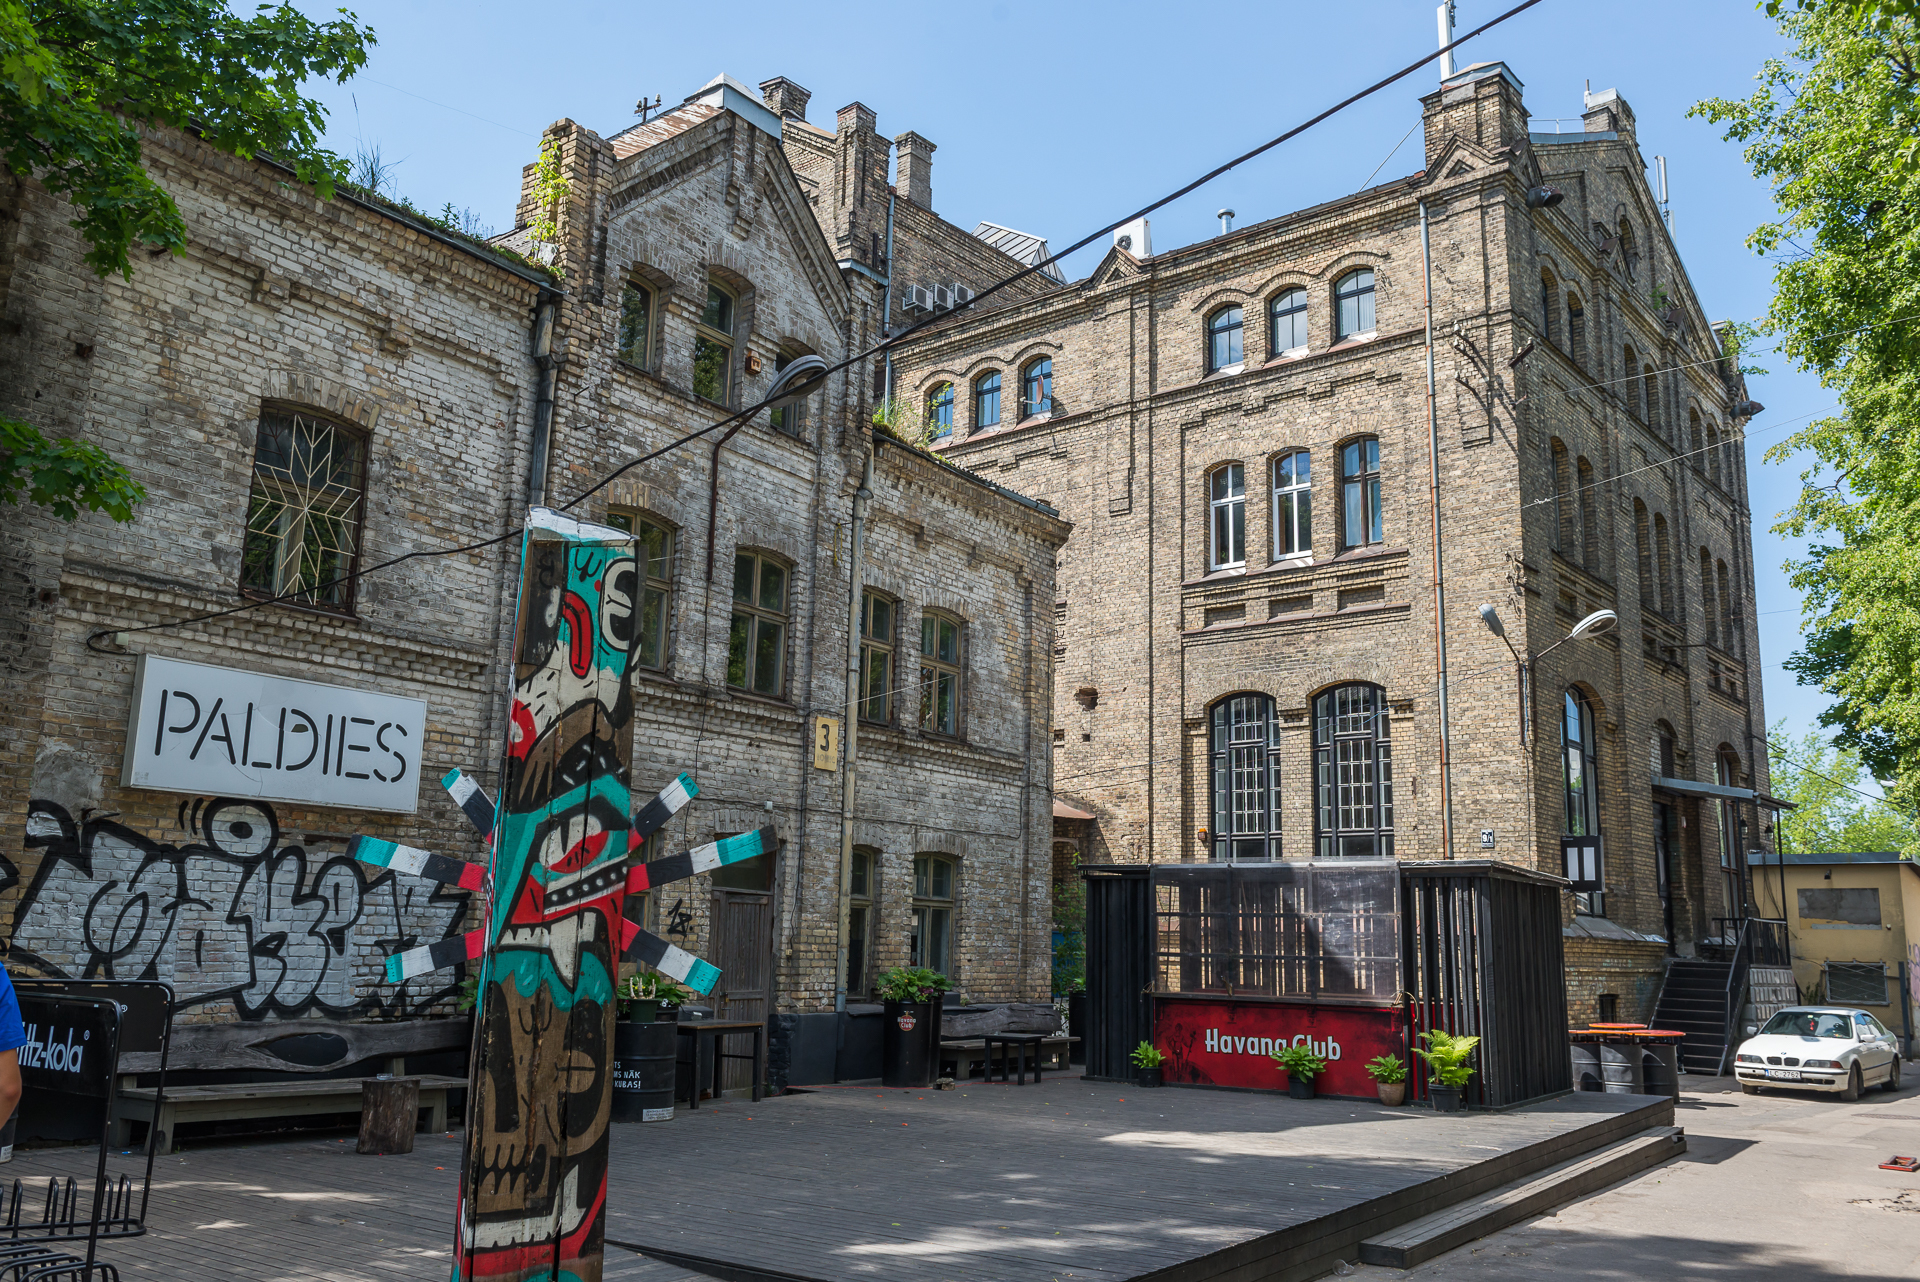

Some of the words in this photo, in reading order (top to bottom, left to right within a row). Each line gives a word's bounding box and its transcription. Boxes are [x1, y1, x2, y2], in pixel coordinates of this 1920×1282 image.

[155, 689, 407, 783] PALDIES
[820, 724, 830, 751] 3
[1205, 1028, 1287, 1056] Havana
[1292, 1034, 1342, 1061] Club
[614, 1080, 641, 1089] KUBAS!
[623, 1069, 641, 1079] NĀK
